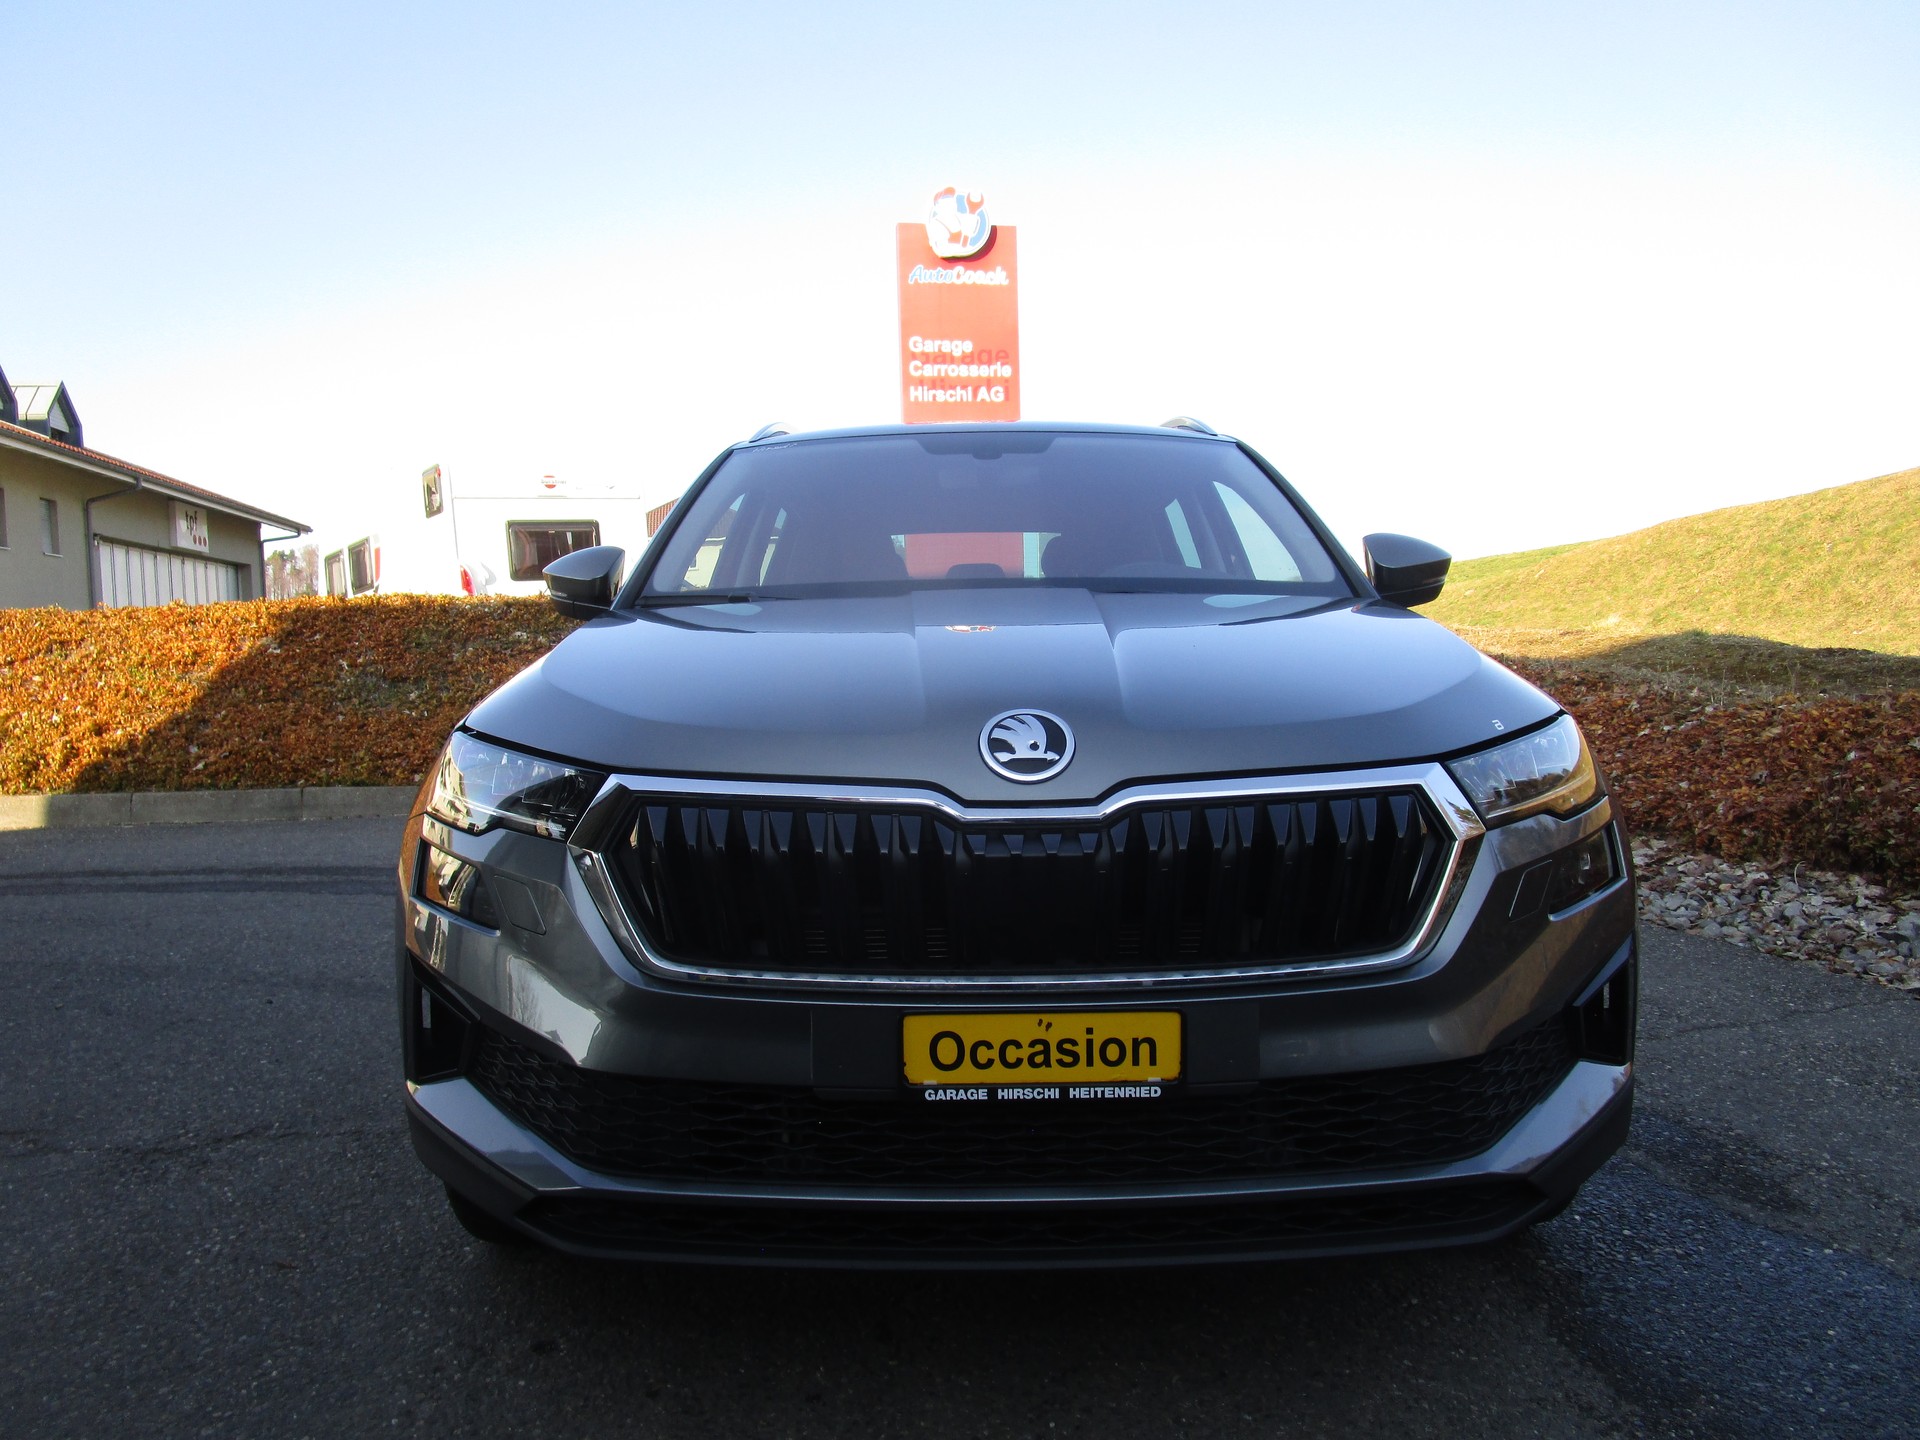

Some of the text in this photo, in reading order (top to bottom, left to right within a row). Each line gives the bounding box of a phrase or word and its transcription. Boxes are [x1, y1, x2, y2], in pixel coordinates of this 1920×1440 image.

[908, 264, 1009, 285] AutoCoach
[908, 335, 973, 357] Garage
[908, 360, 1012, 377] Carrosserie
[909, 385, 1005, 402] Hirschi AG
[185, 510, 198, 536] tpf
[929, 1027, 1158, 1072] Occasion
[924, 1086, 1162, 1101] GARAGE HIRSCHI HEITENRIED
